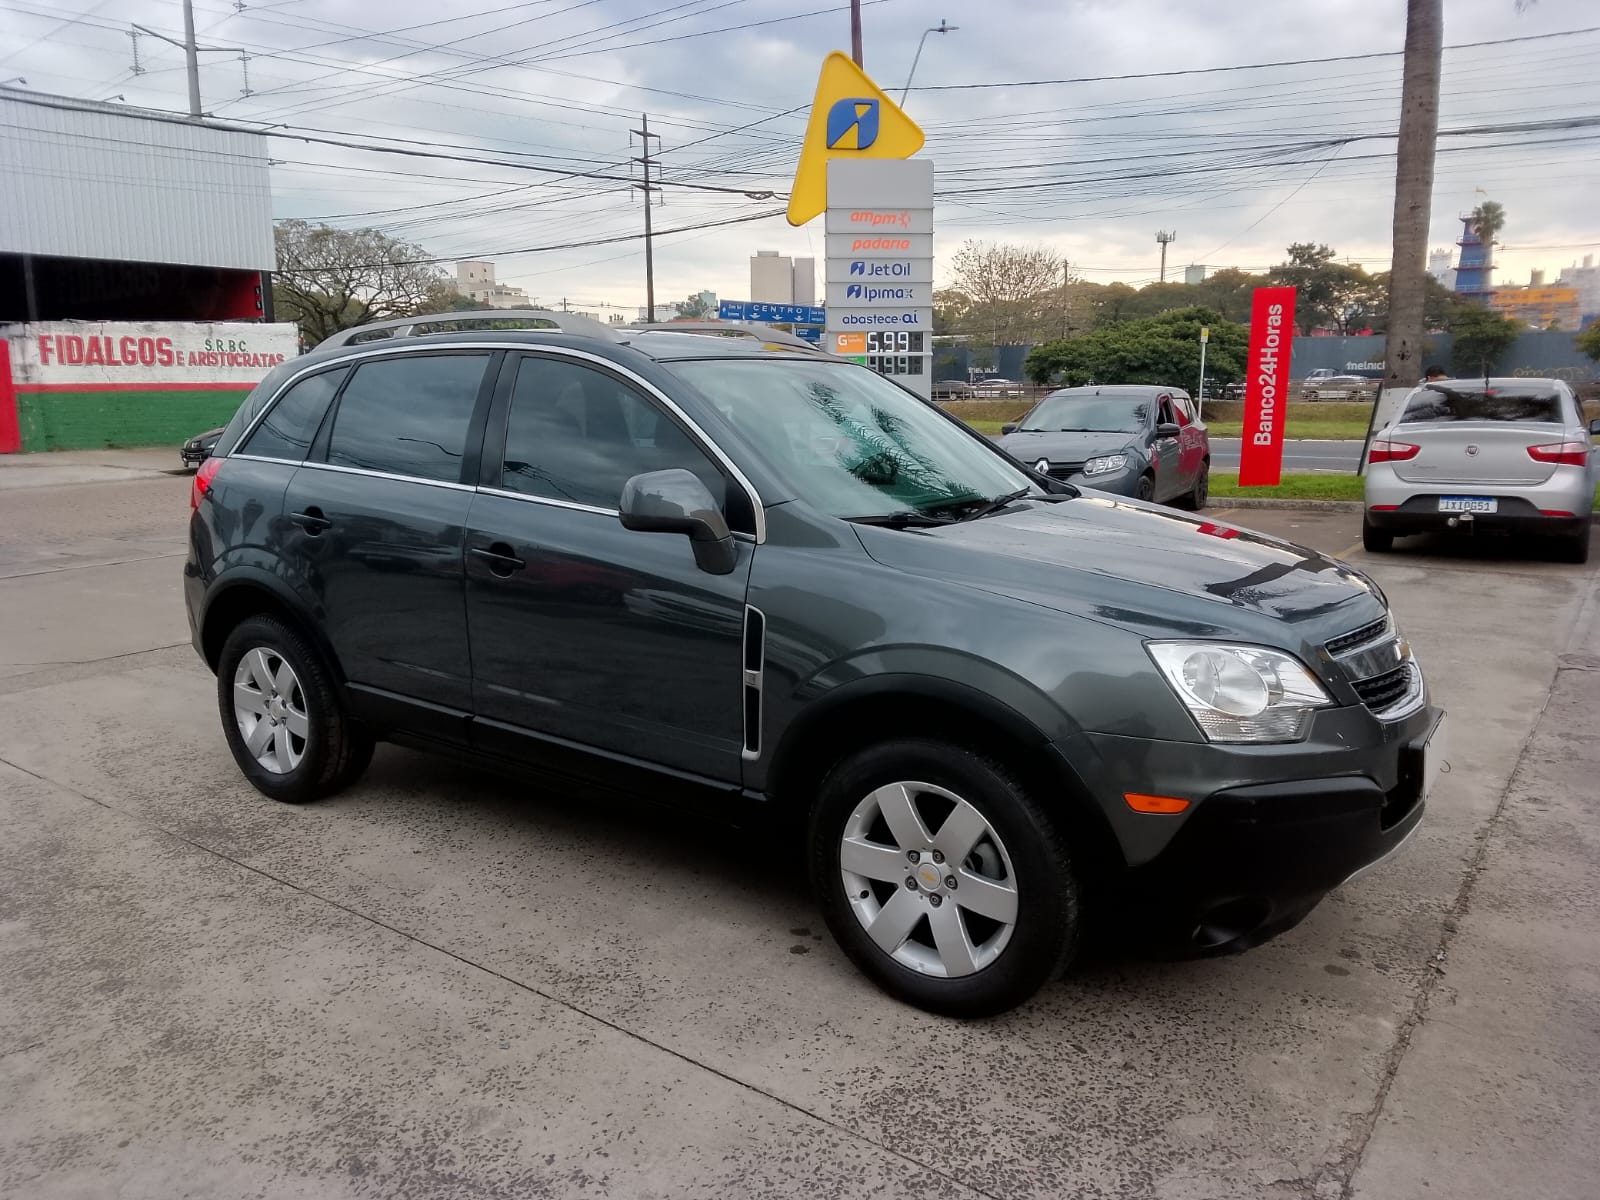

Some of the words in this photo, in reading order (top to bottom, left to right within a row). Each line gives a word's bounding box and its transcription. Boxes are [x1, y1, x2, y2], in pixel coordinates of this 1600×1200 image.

[850, 211, 897, 227] ampm
[851, 237, 911, 252] padaria
[753, 304, 803, 314] CENTRO
[838, 334, 848, 346] G
[38, 334, 174, 367] FIDALGOS
[175, 350, 185, 367] E
[187, 351, 284, 368] ARISTOCRATAS
[1253, 304, 1283, 446] Banco24Horas
